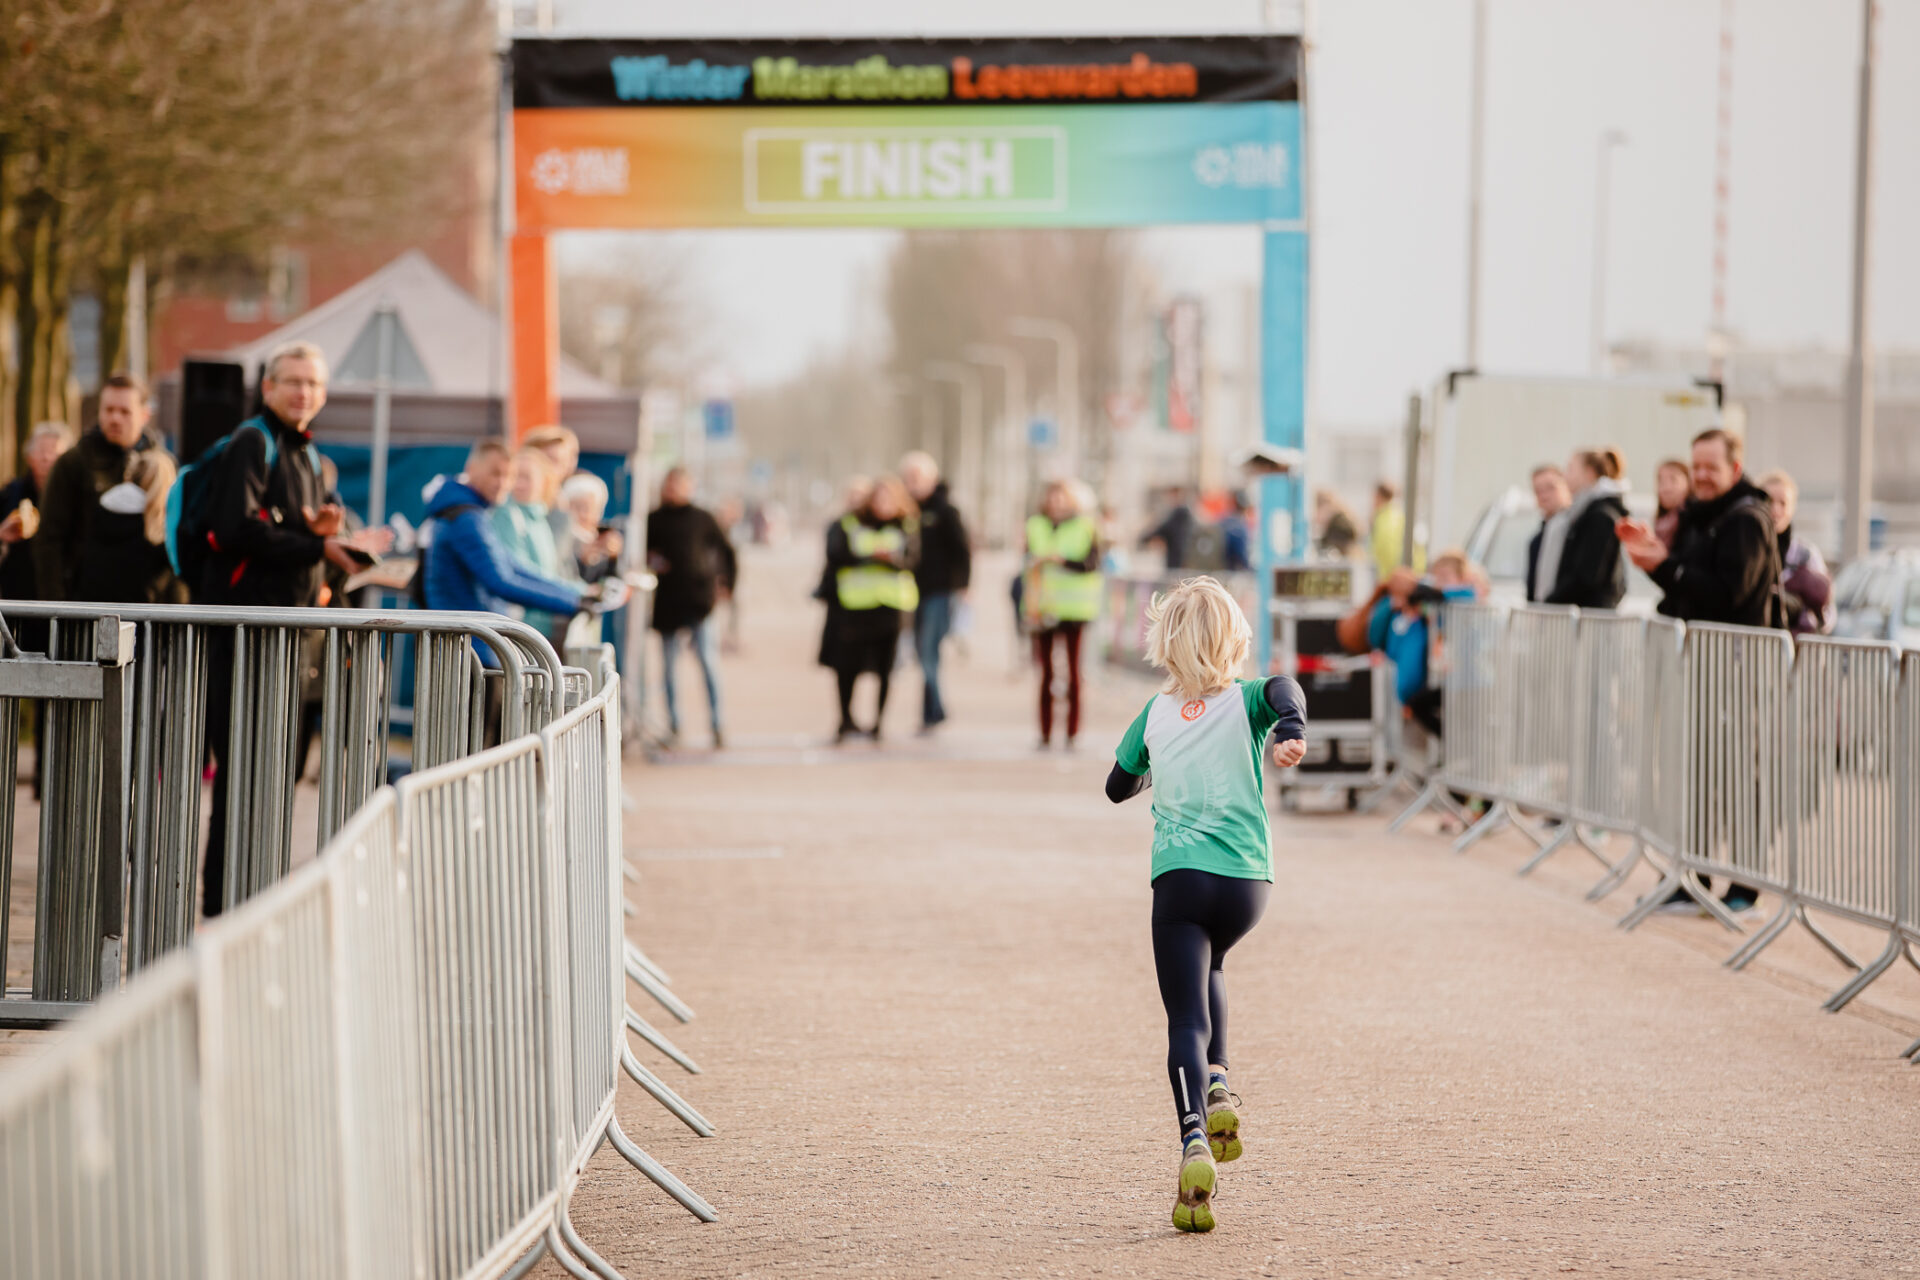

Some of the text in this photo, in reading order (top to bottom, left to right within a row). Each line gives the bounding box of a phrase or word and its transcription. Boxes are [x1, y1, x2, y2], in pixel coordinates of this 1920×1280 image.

[611, 53, 1198, 99] Winter Marathon Leeuwarden
[802, 140, 1013, 199] FINISH
